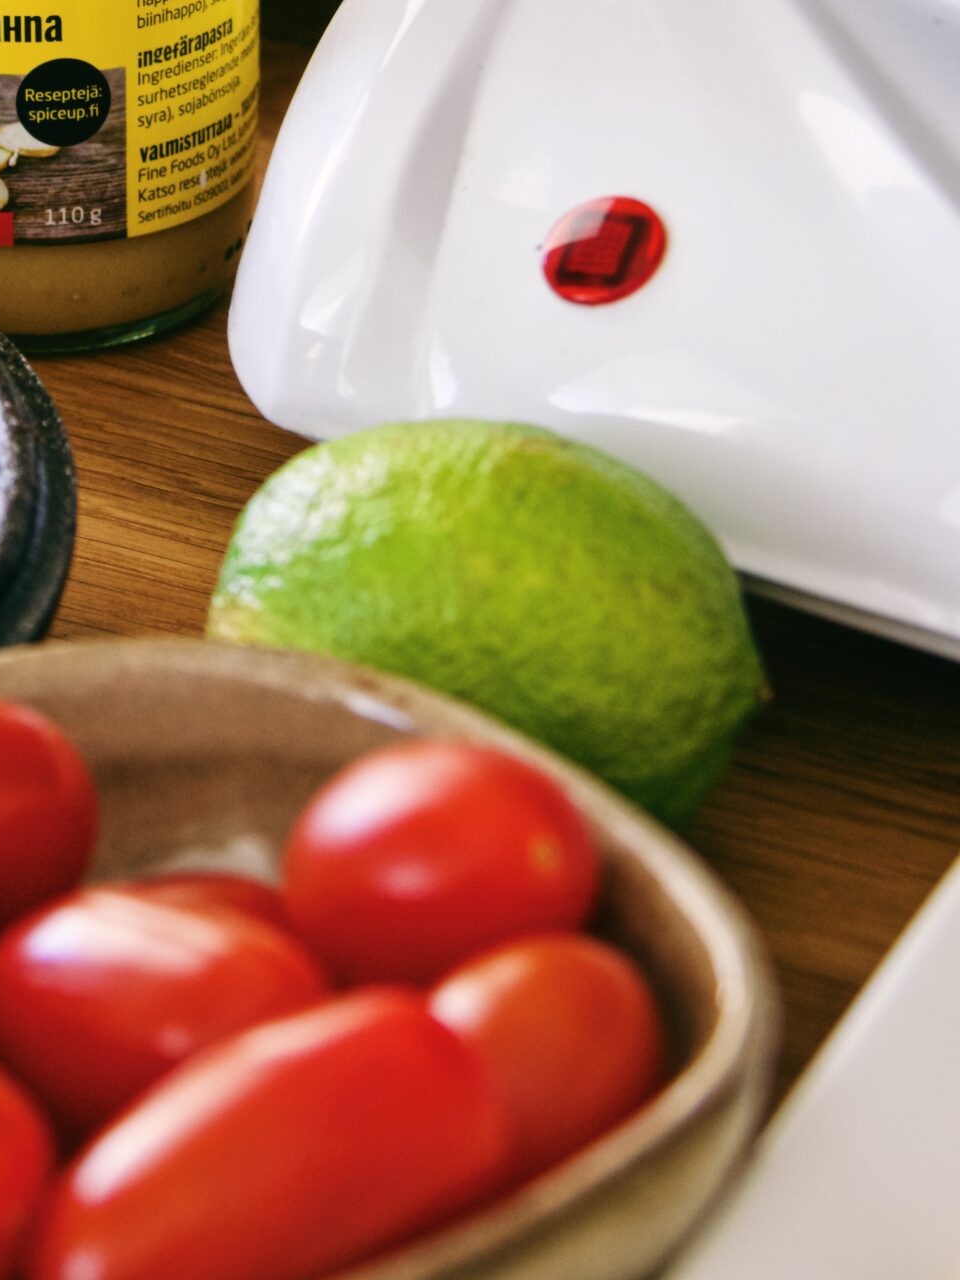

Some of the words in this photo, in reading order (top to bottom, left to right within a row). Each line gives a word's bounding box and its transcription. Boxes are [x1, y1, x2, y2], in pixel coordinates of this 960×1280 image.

[138, 50, 218, 85] Ingredienser:
[24, 86, 103, 114] Reseptejä:
[28, 103, 100, 122] spiceup.fi
[138, 108, 174, 129] syra),
[138, 162, 167, 183] Fine
[171, 150, 205, 174] Foods
[208, 144, 220, 159] Oy
[138, 182, 175, 203] Katso
[44, 206, 83, 226] 110
[90, 208, 102, 225] g
[138, 198, 192, 224] Sertifioitu
